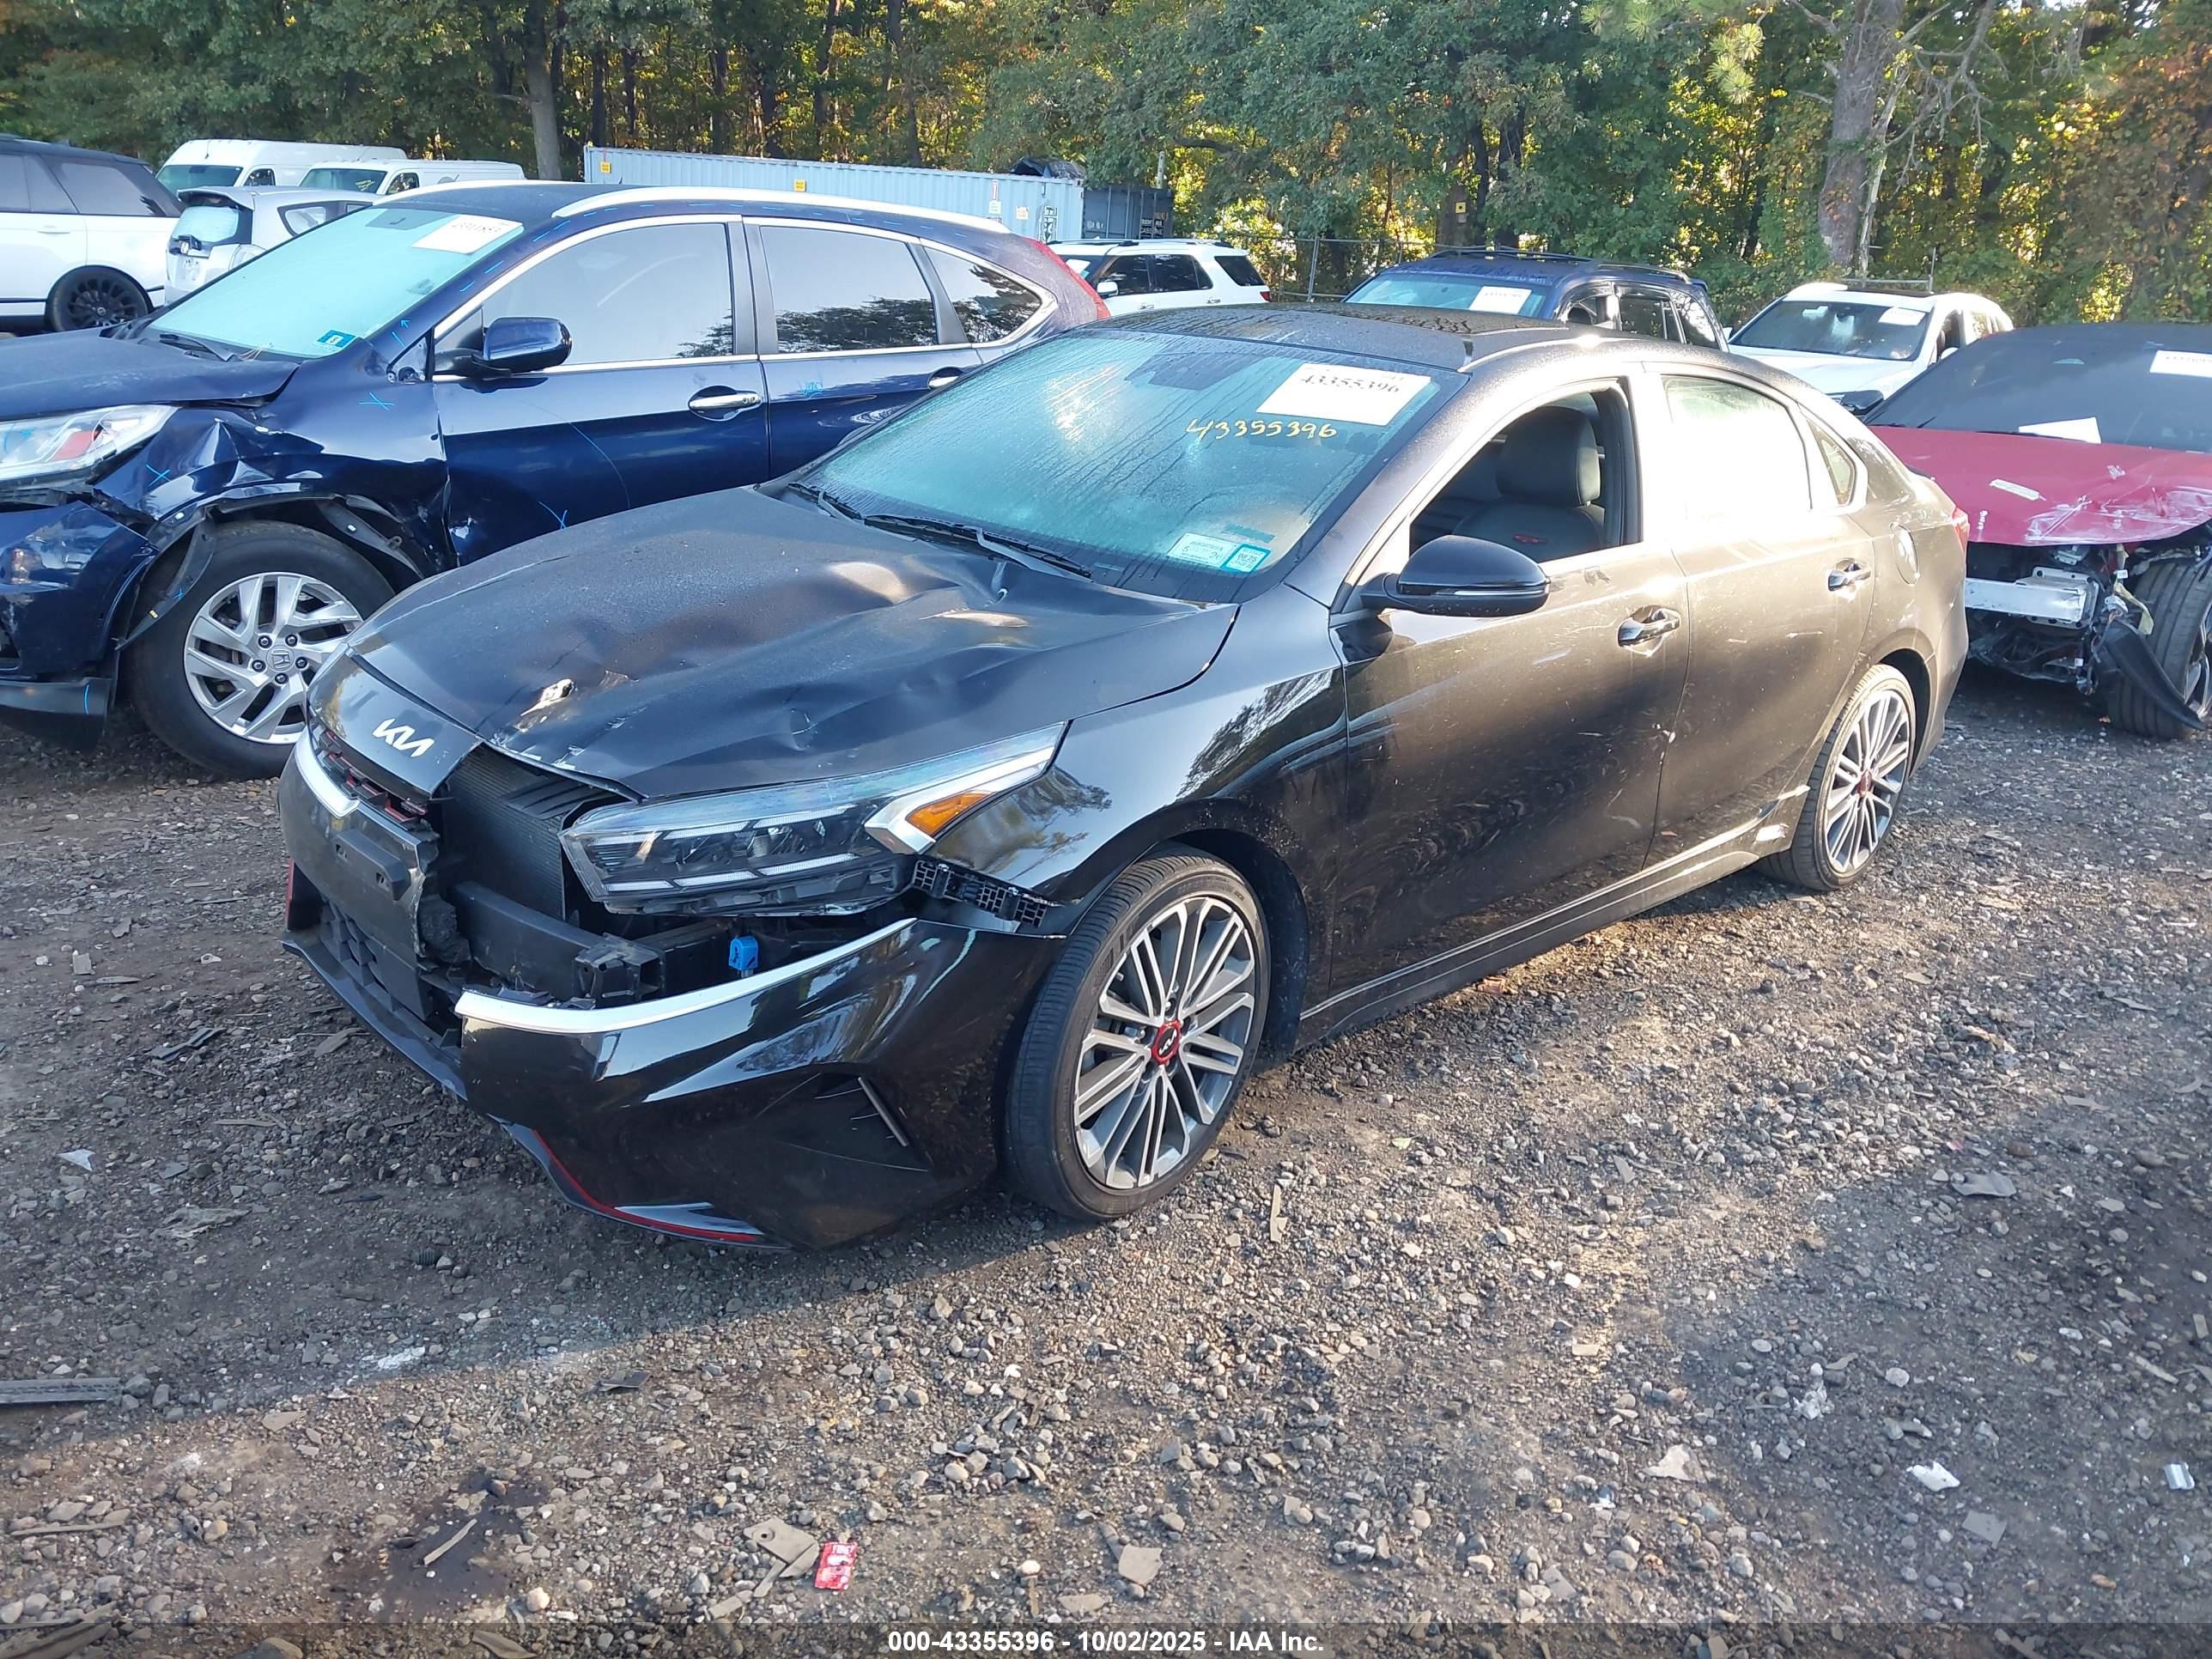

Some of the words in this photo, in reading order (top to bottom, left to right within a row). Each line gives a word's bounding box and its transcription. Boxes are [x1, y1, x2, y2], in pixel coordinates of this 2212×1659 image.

[1300, 374, 1400, 392] 43355396
[1185, 418, 1337, 440] 43355396
[372, 718, 435, 757] KIA
